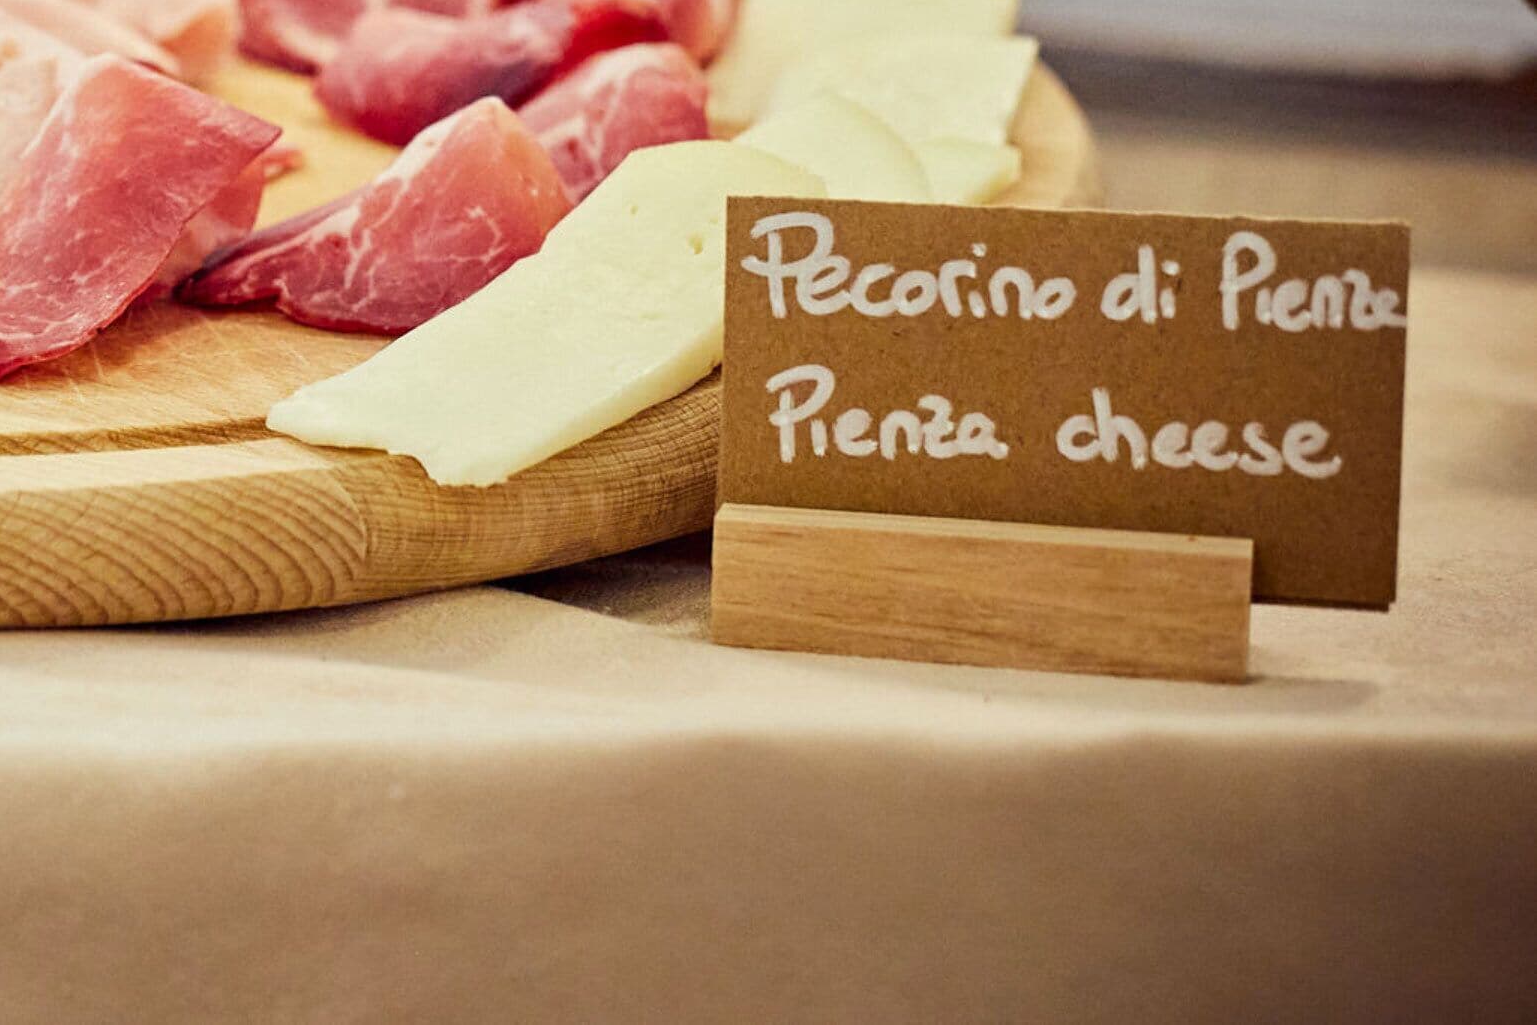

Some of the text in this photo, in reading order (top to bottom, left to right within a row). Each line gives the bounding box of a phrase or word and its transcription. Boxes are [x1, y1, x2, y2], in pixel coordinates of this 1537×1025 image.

[741, 211, 1407, 332] Pecorino di Pienza
[766, 364, 1342, 479] Pienza cheese
